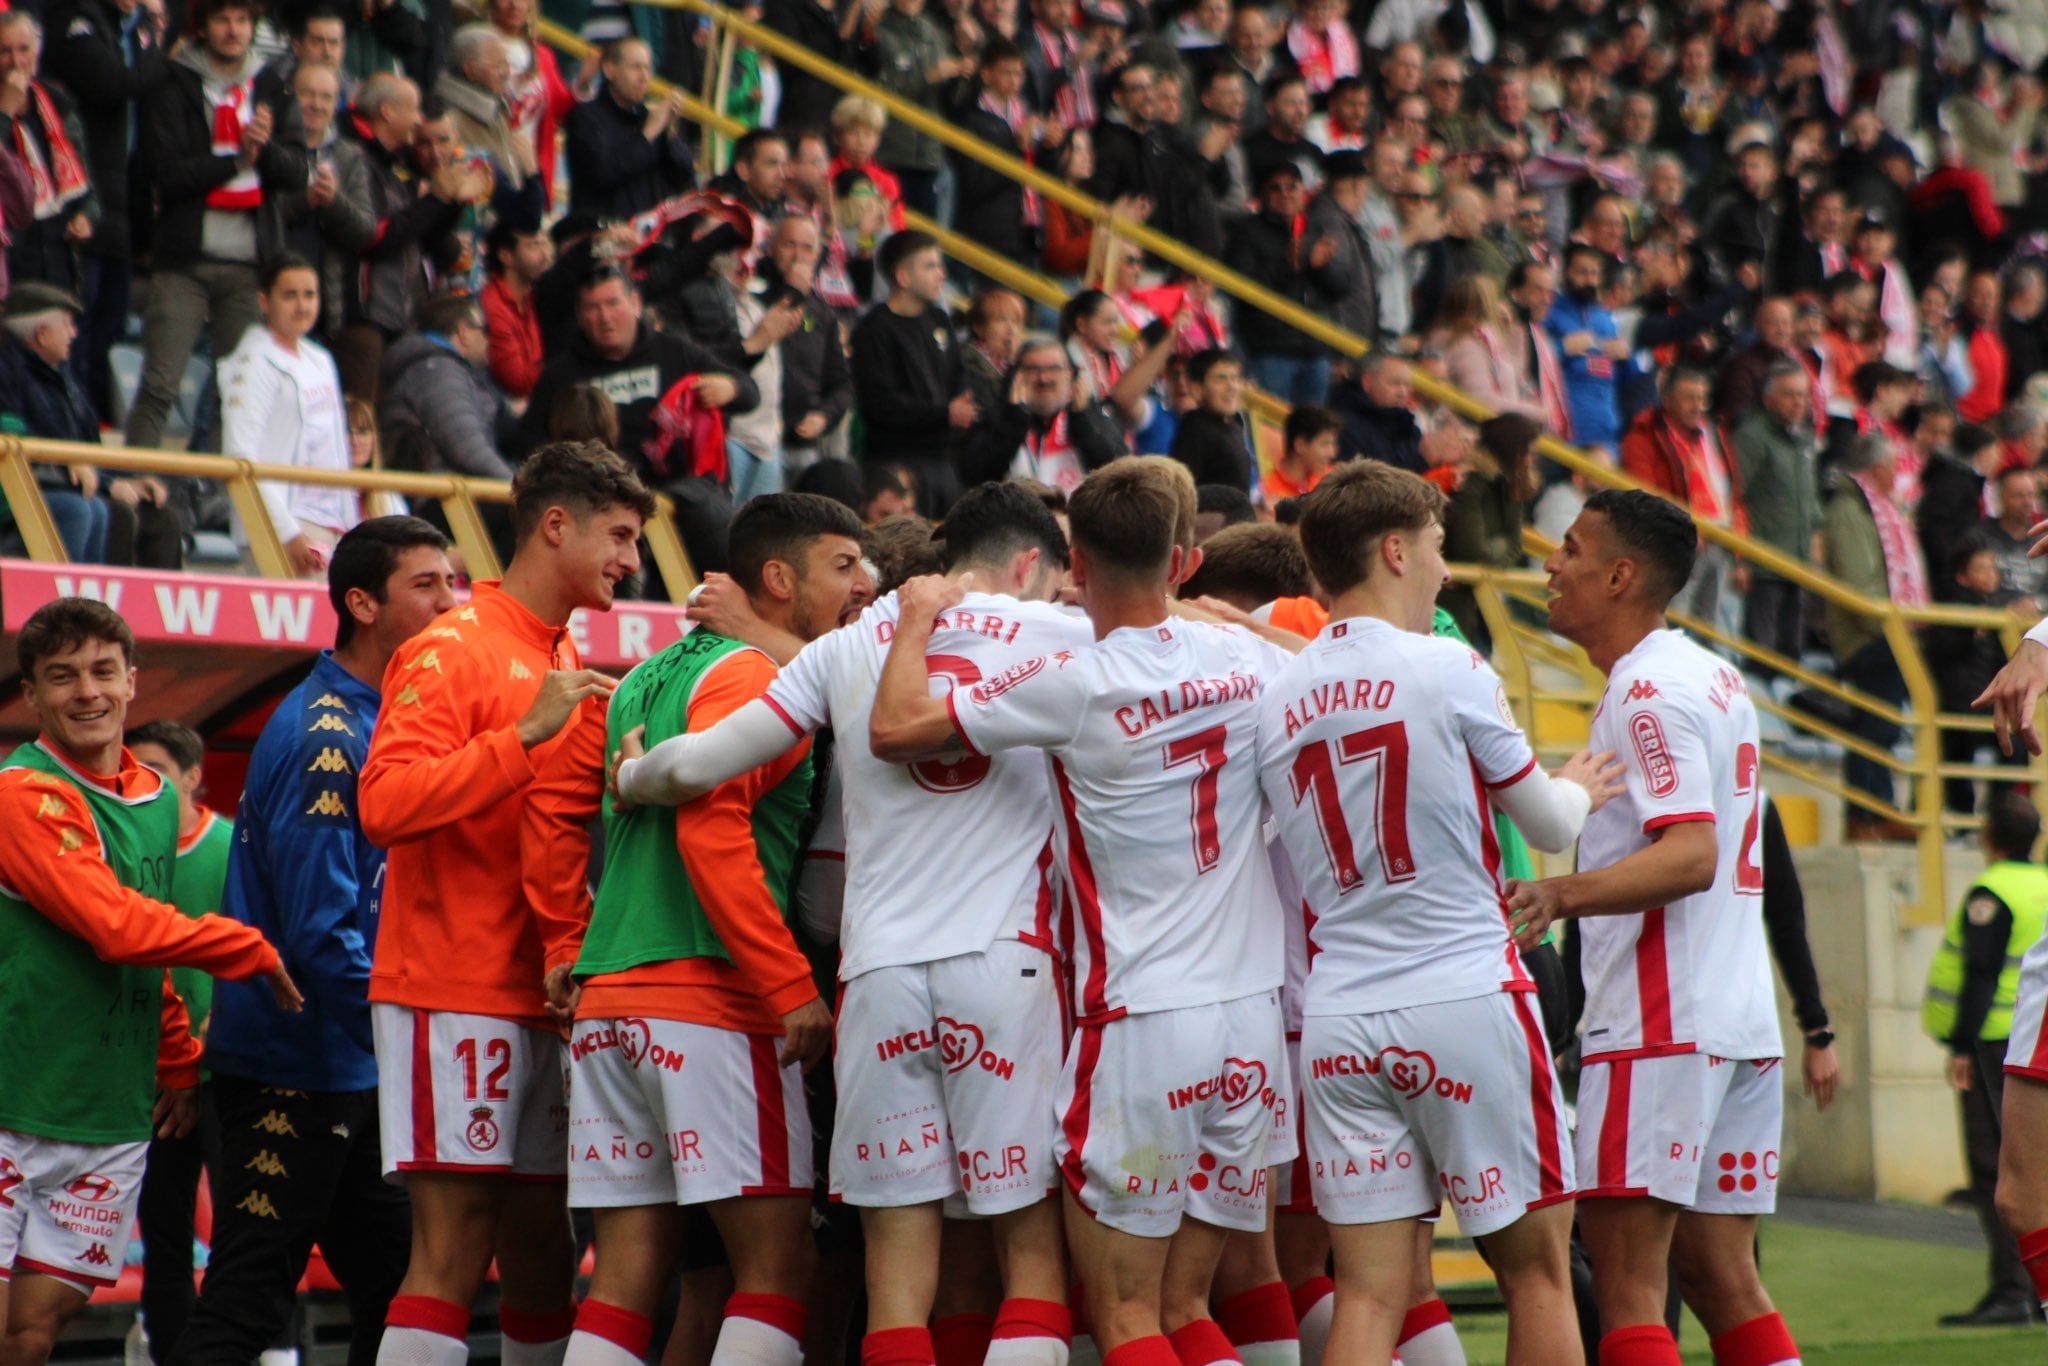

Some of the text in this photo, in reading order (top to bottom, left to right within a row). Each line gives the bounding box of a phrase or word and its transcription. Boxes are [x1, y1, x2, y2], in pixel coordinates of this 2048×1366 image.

[1284, 678, 1396, 741] ÁLVARO
[1633, 716, 1674, 795] CERIESA
[1161, 724, 1229, 876] 7
[1287, 719, 1417, 896] 17
[453, 1037, 512, 1103] 12
[973, 1145, 1028, 1182] CJR
[1315, 1149, 1412, 1179] RIAÑO
[1451, 1166, 1506, 1205] CJR
[48, 1199, 123, 1225] HYUNDAI
